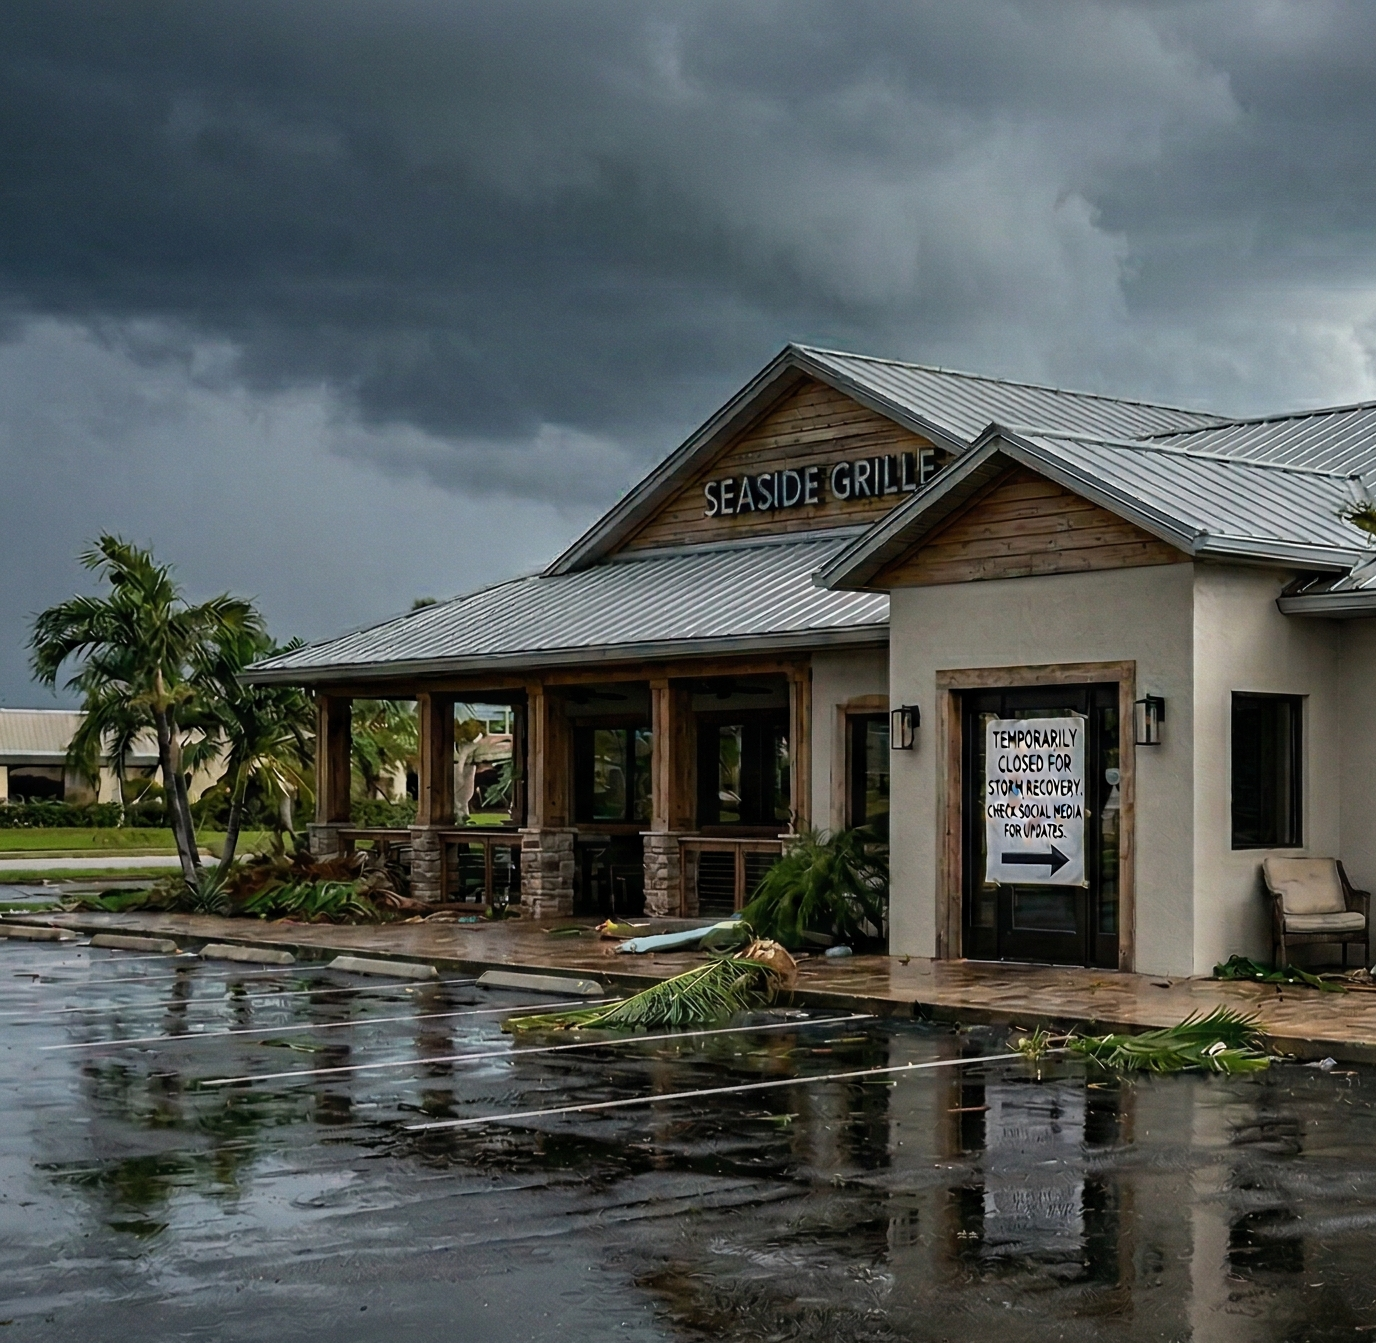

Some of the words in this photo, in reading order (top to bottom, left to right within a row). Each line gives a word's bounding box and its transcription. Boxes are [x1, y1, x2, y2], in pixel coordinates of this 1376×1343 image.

[703, 466, 820, 518] SEASIDE
[830, 449, 935, 500] GRILLE
[993, 729, 1078, 750] TEMPORARILY
[998, 754, 1044, 773] CLOSED
[1048, 754, 1072, 773] FOR
[1026, 778, 1083, 797] RECOVERY.
[987, 803, 1018, 819] CHECK
[1018, 803, 1051, 819] SOCIAL
[1004, 823, 1022, 838] FOR
